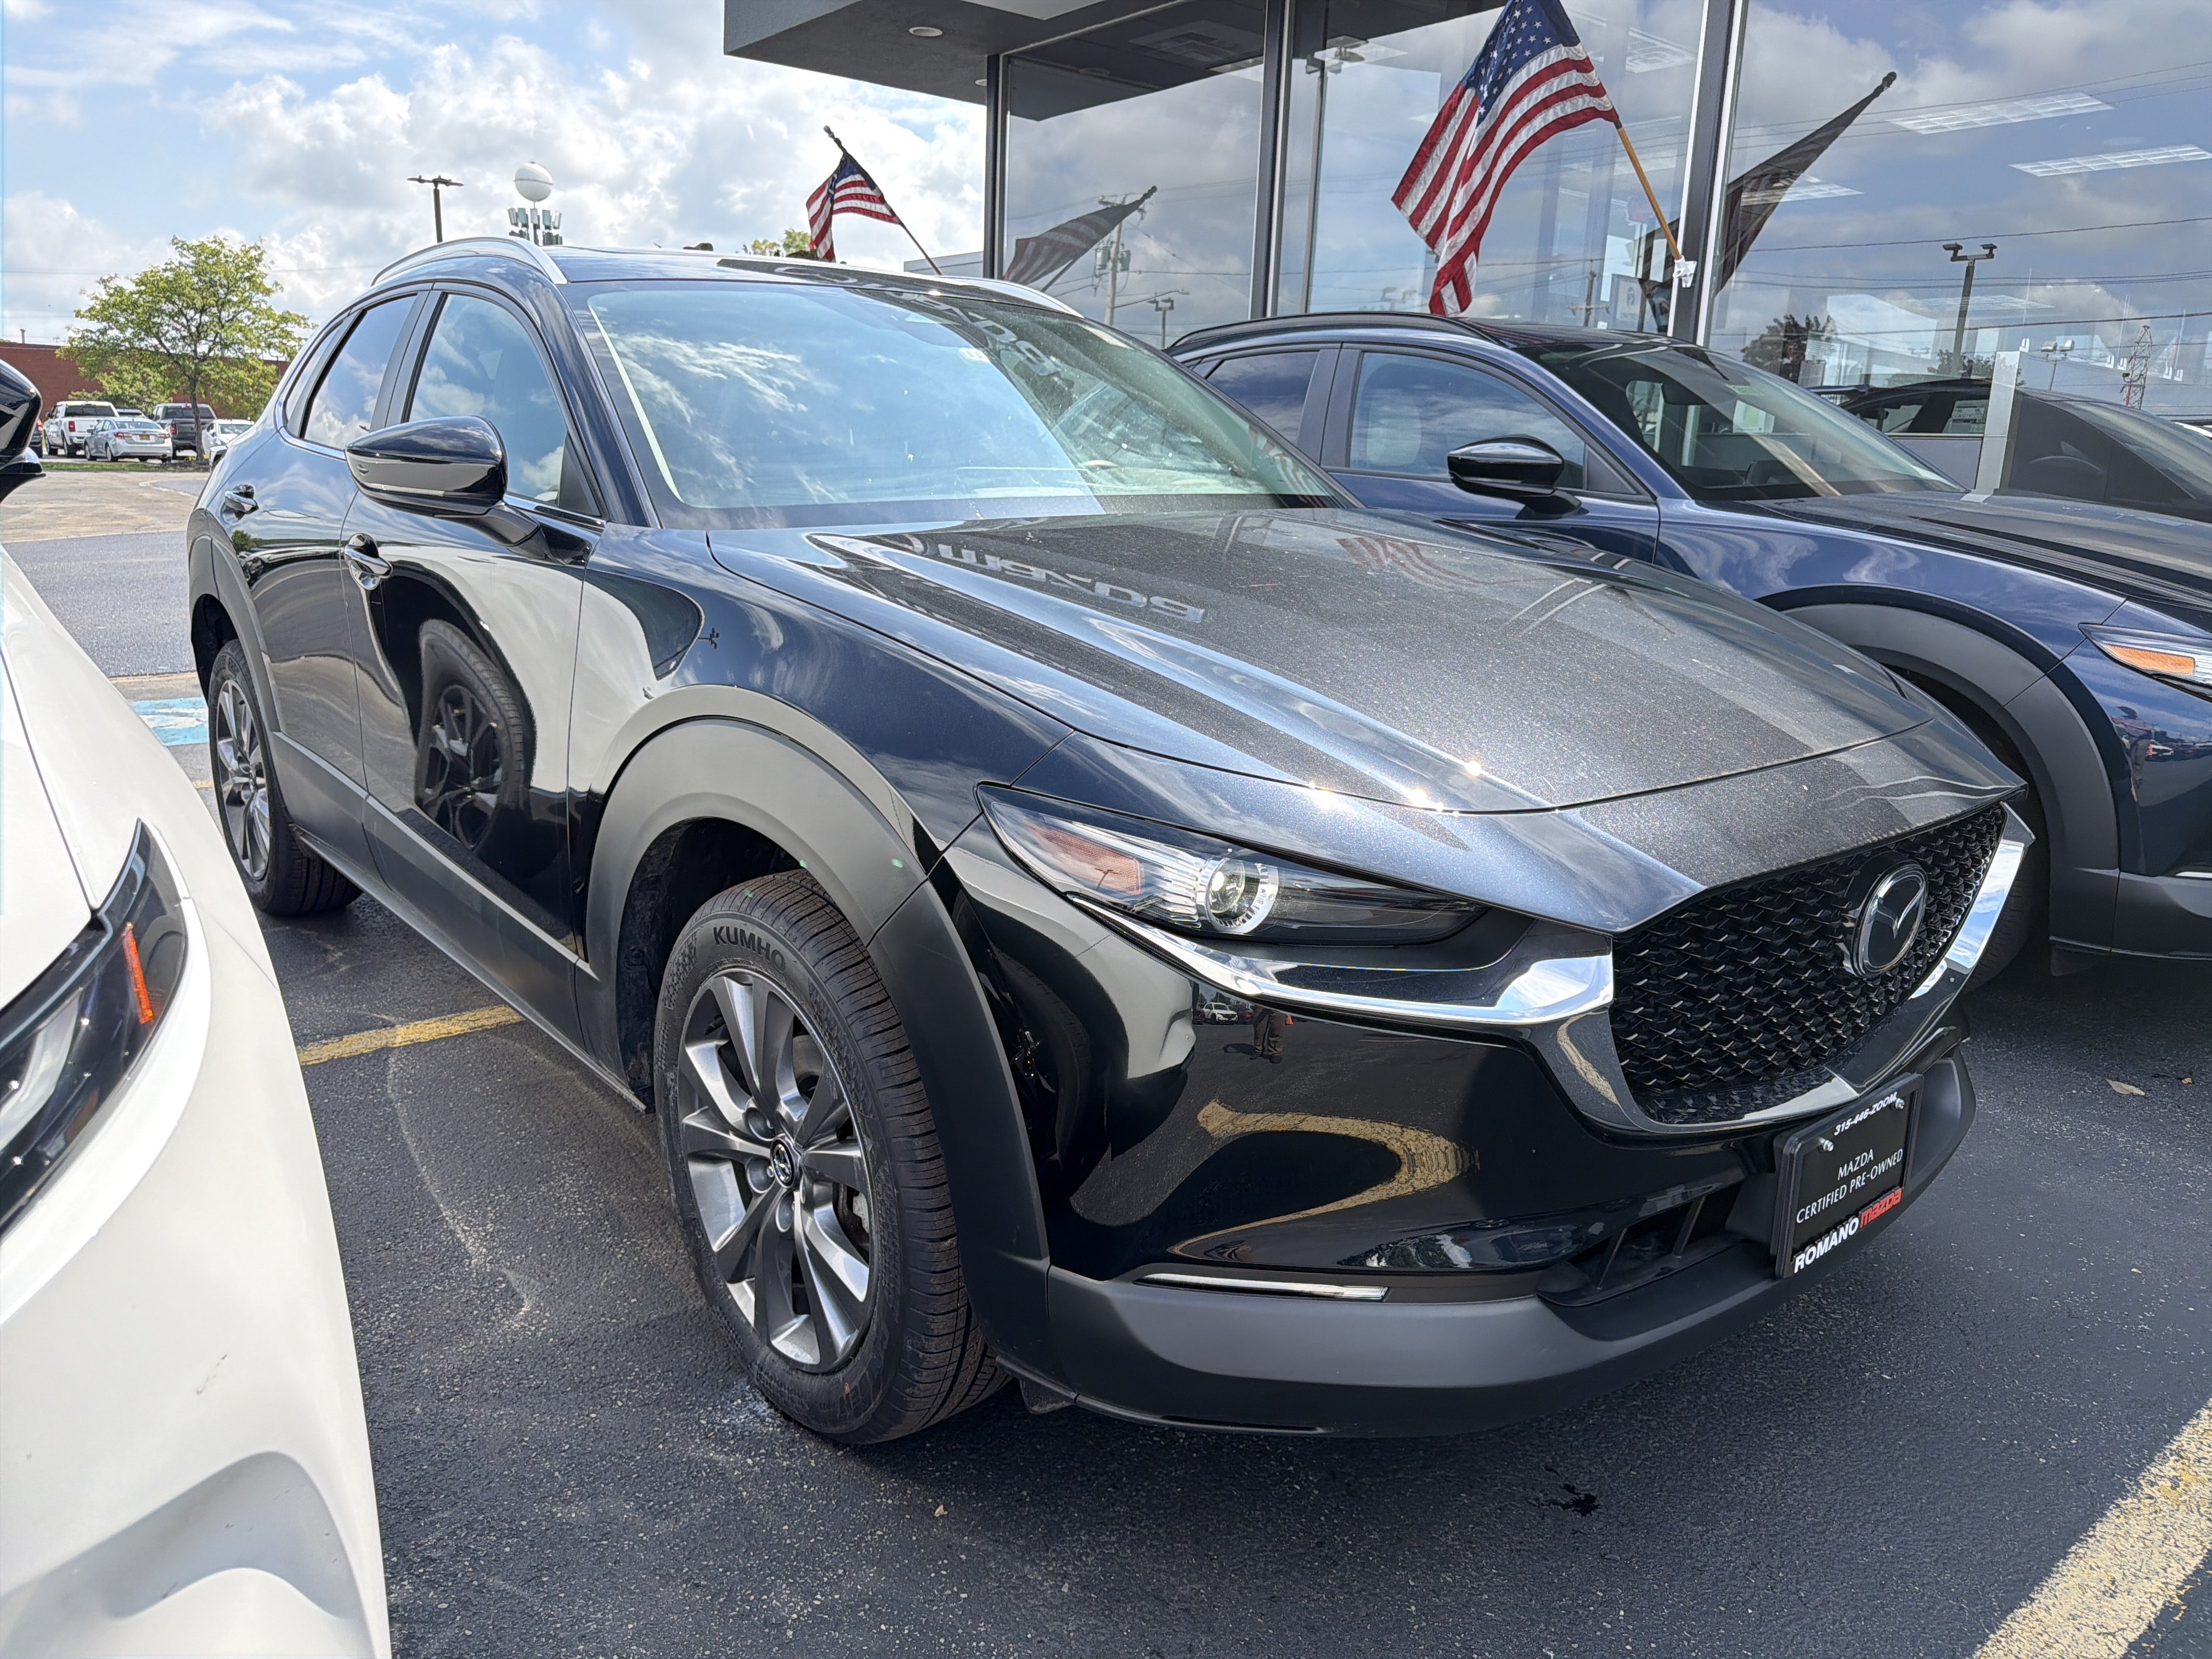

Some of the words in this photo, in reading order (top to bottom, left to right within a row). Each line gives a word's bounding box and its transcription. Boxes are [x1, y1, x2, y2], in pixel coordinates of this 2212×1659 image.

[713, 926, 787, 974] KUMHO
[1834, 1091, 1898, 1136] 315-446-ZOOM
[1796, 1184, 1847, 1224] CERTIFIED
[1849, 1148, 1903, 1193] PRE-OWNED
[1838, 1148, 1874, 1181] MAZDA
[1794, 1217, 1859, 1274] ROMANO
